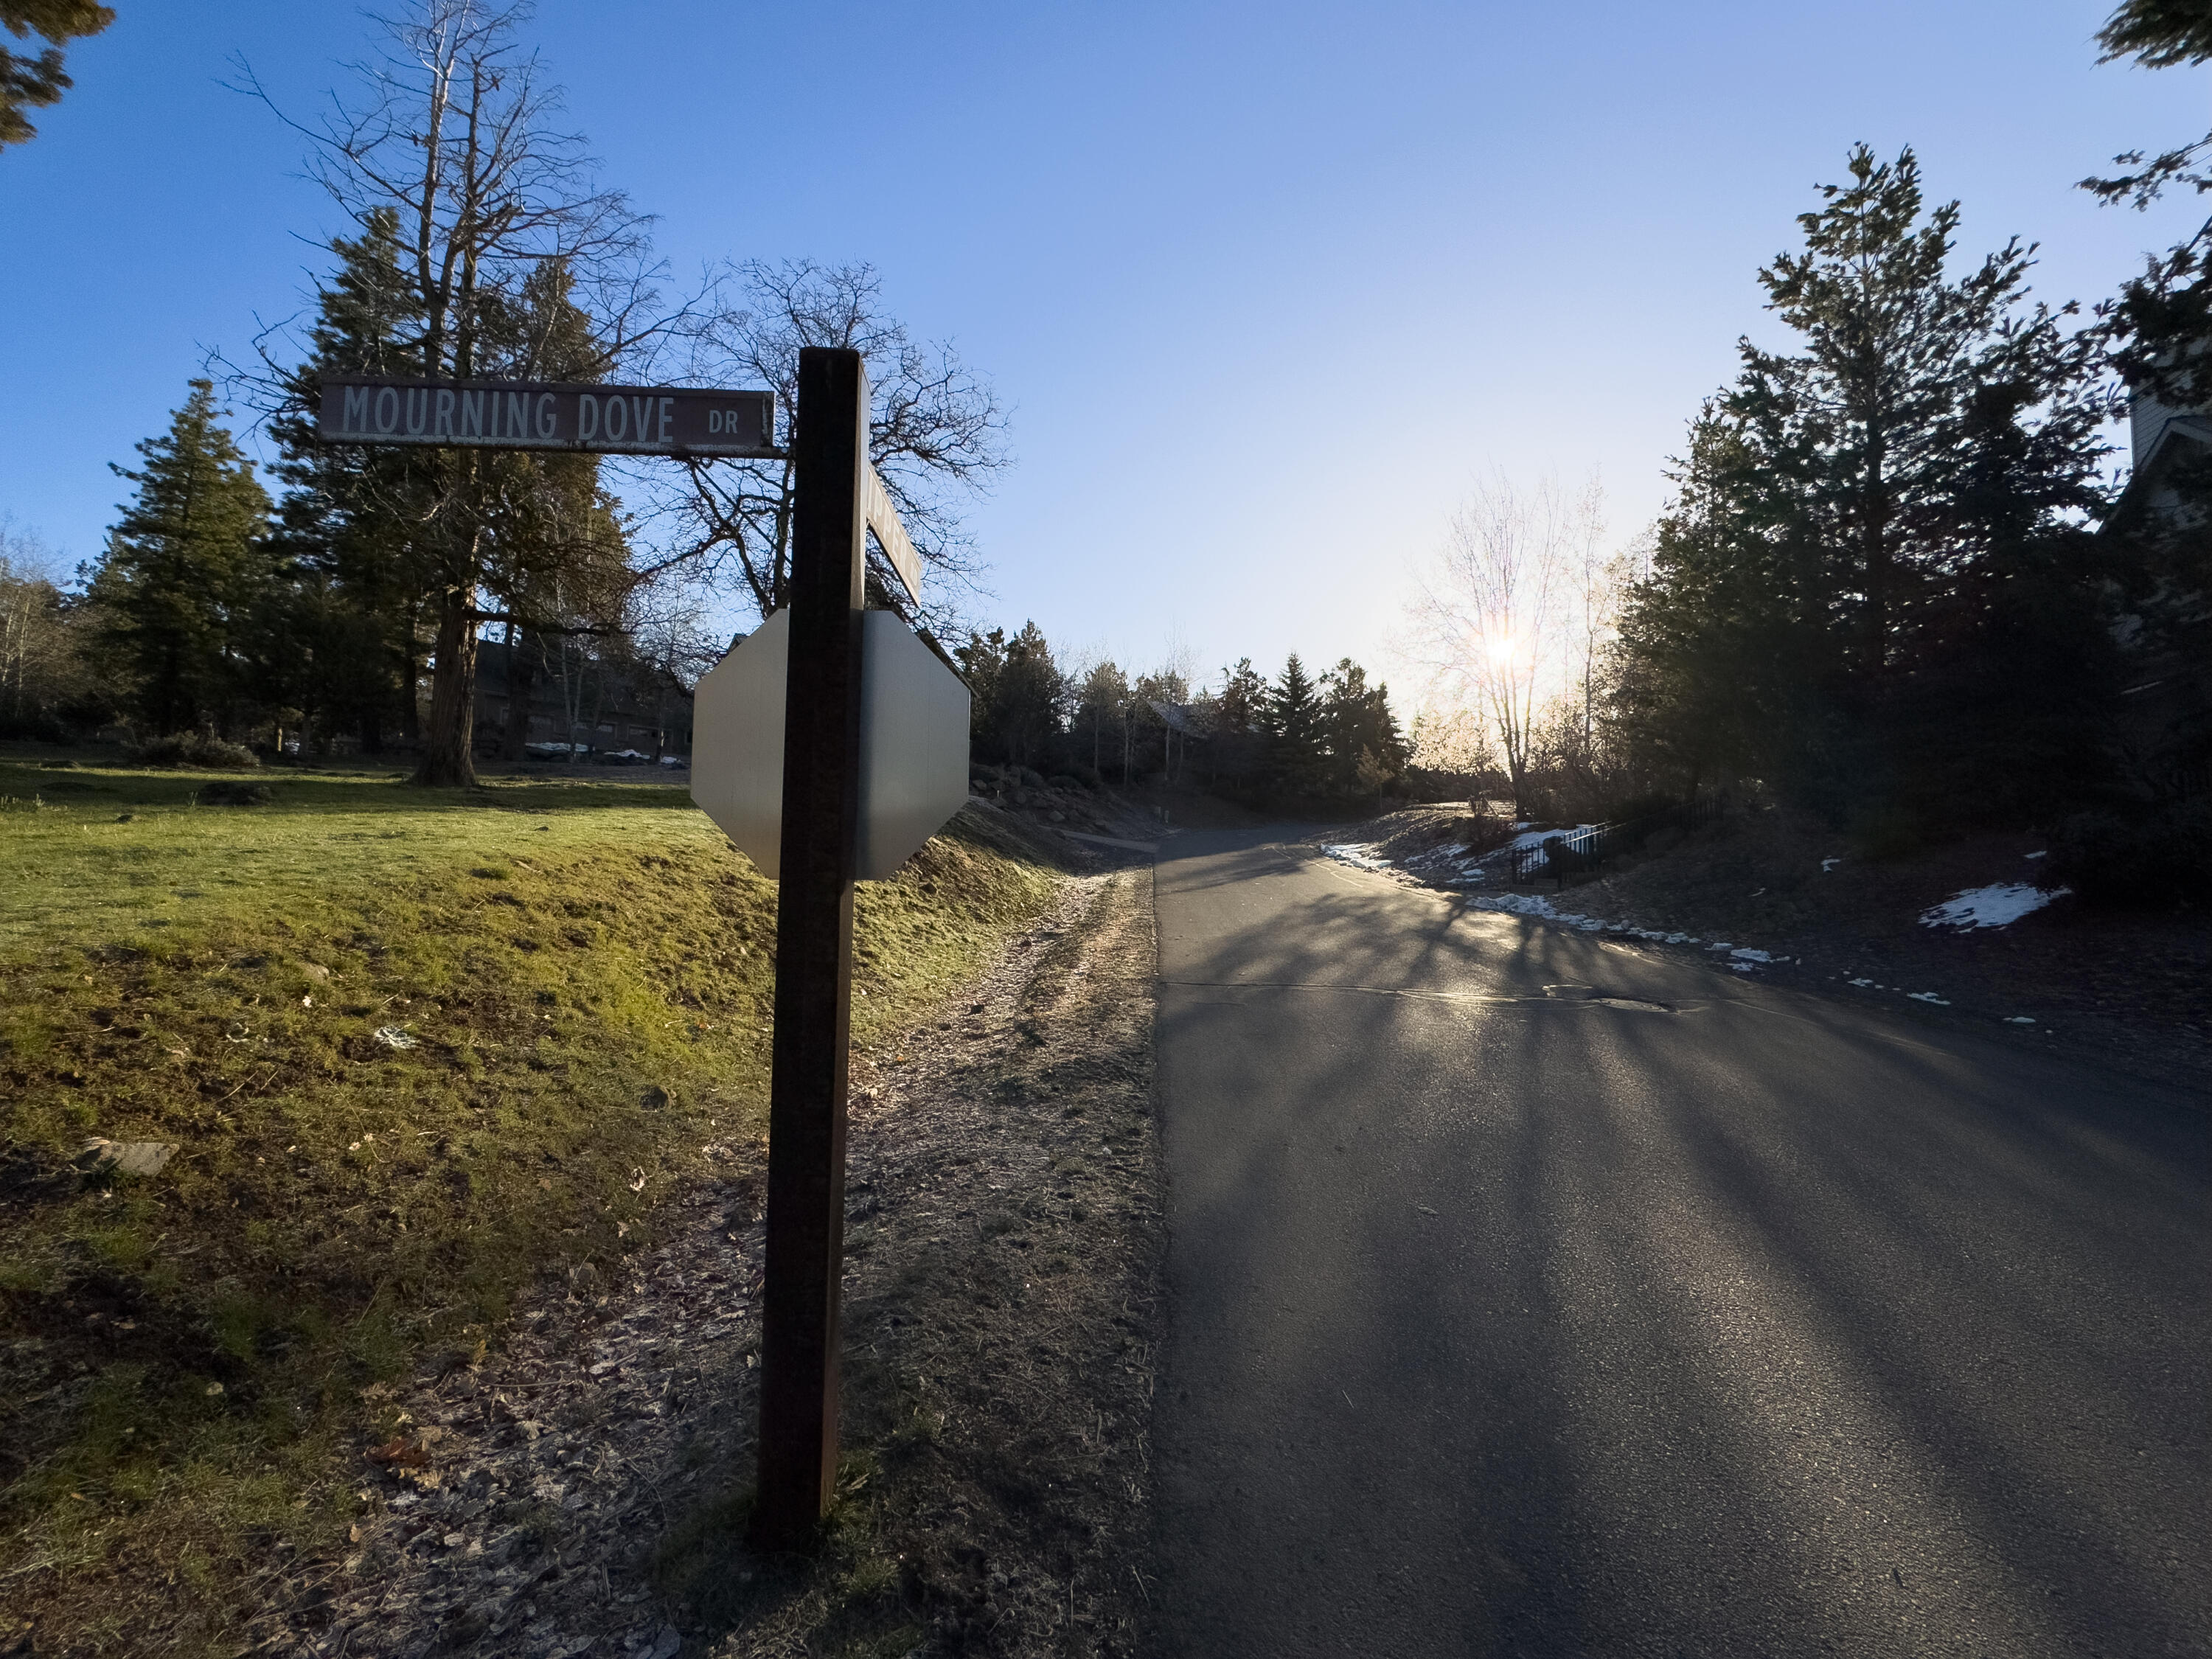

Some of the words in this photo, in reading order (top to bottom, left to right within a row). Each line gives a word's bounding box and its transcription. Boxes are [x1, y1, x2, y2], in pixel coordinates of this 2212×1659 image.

[342, 385, 557, 439] MOURNING
[578, 394, 675, 442] DOVE
[709, 409, 739, 434] DR
[867, 472, 907, 574] PPER
